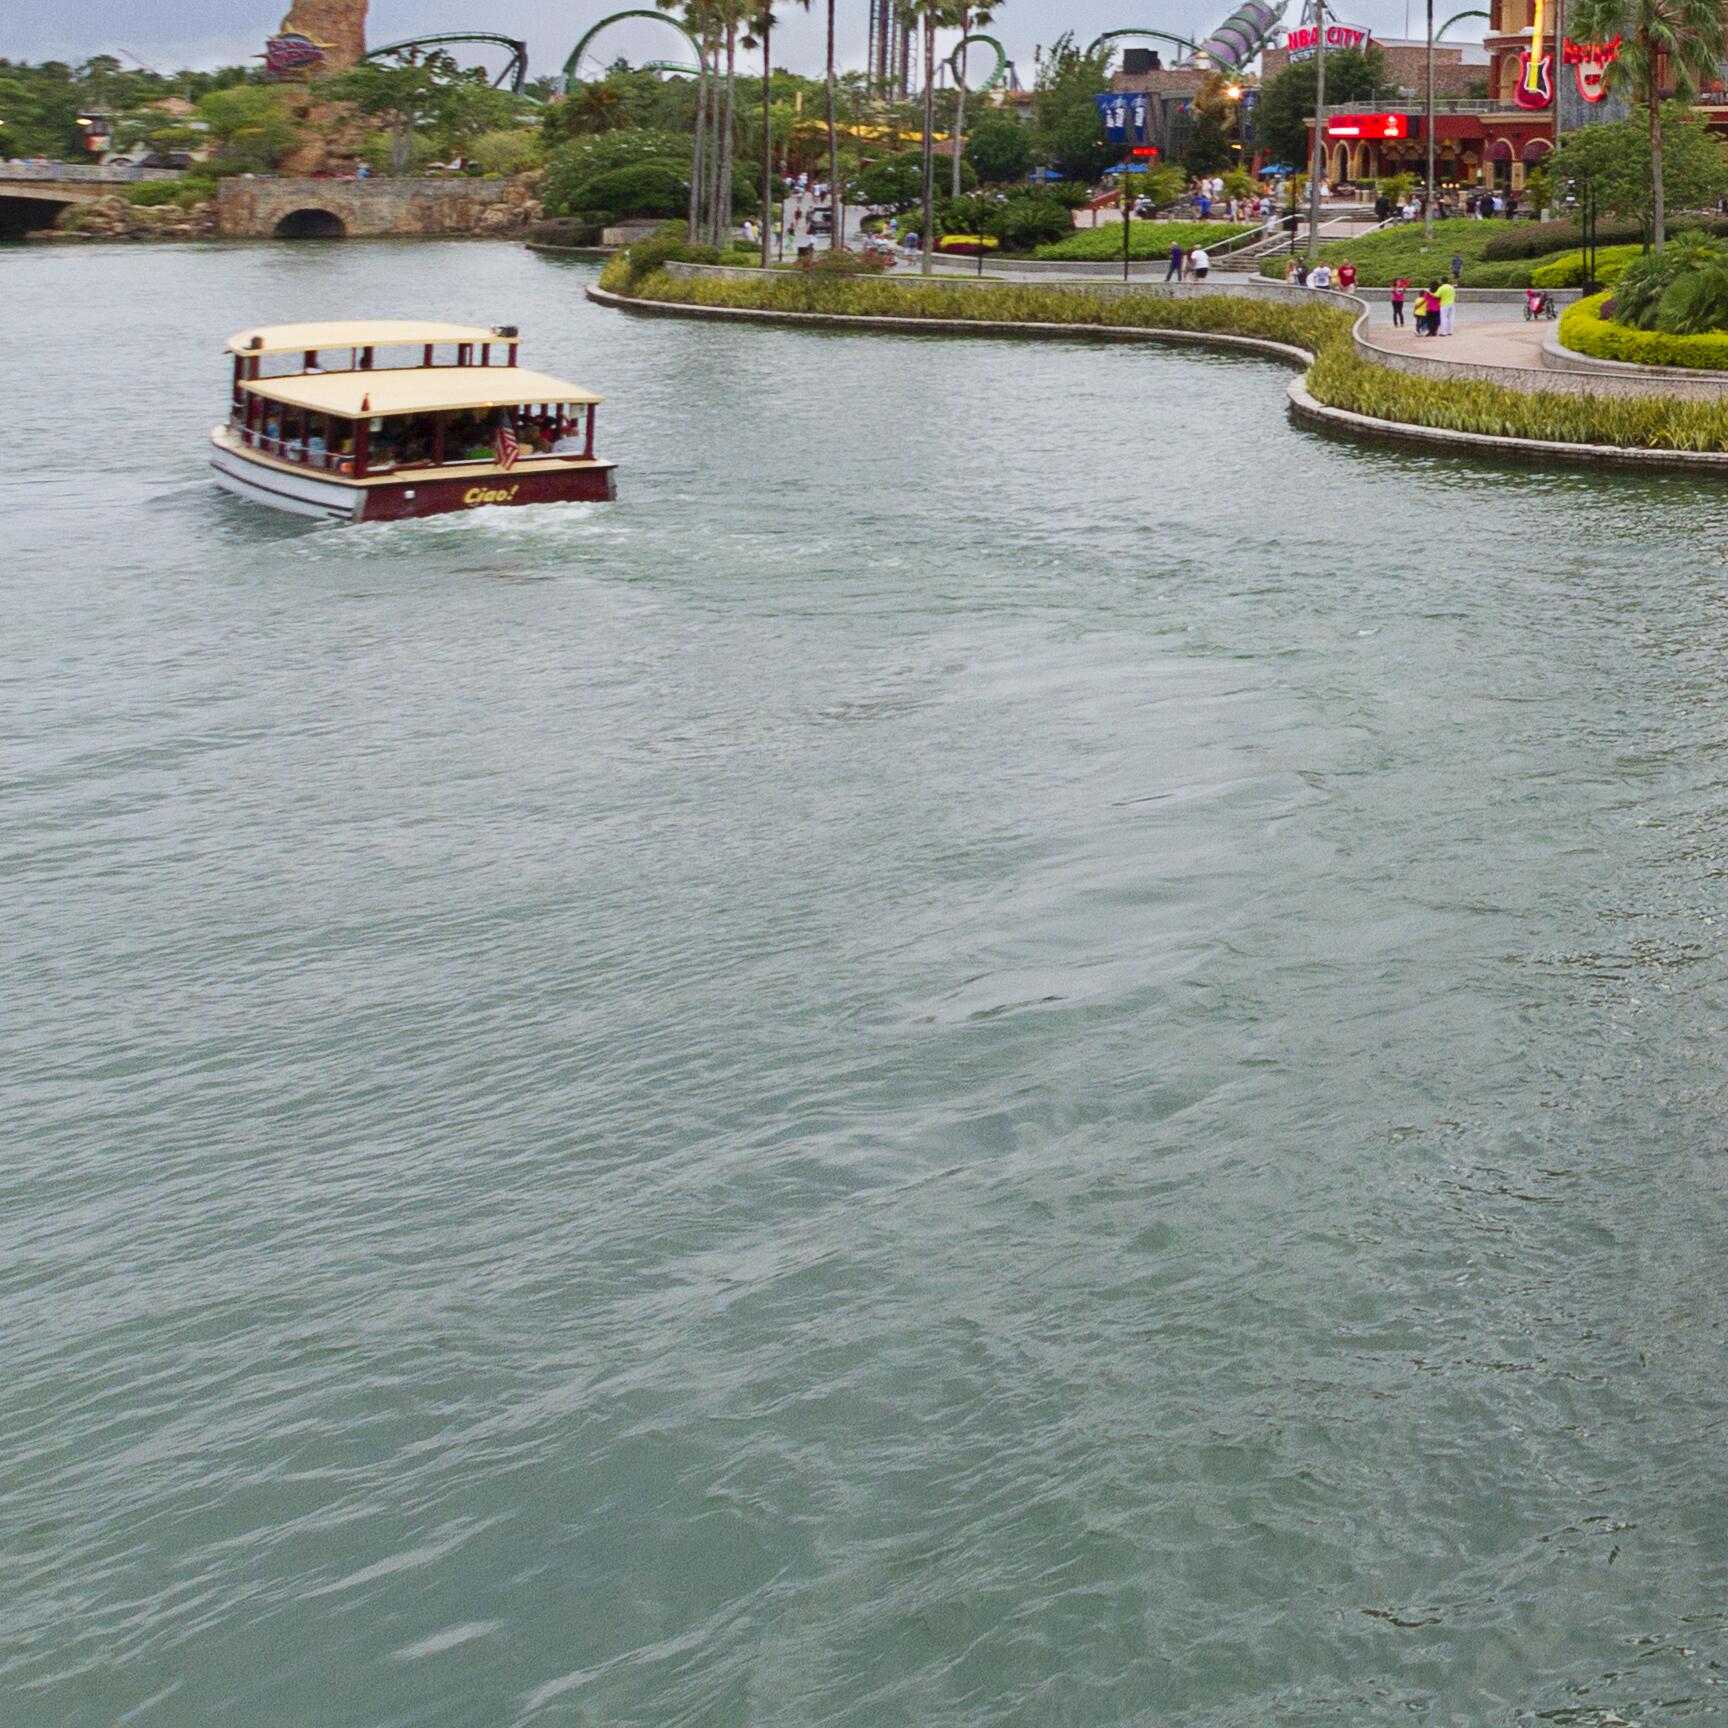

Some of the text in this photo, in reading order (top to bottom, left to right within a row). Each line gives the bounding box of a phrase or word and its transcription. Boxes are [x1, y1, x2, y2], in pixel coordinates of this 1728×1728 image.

[1287, 26, 1363, 50] NBA CITY
[464, 484, 519, 503] Ciao!
